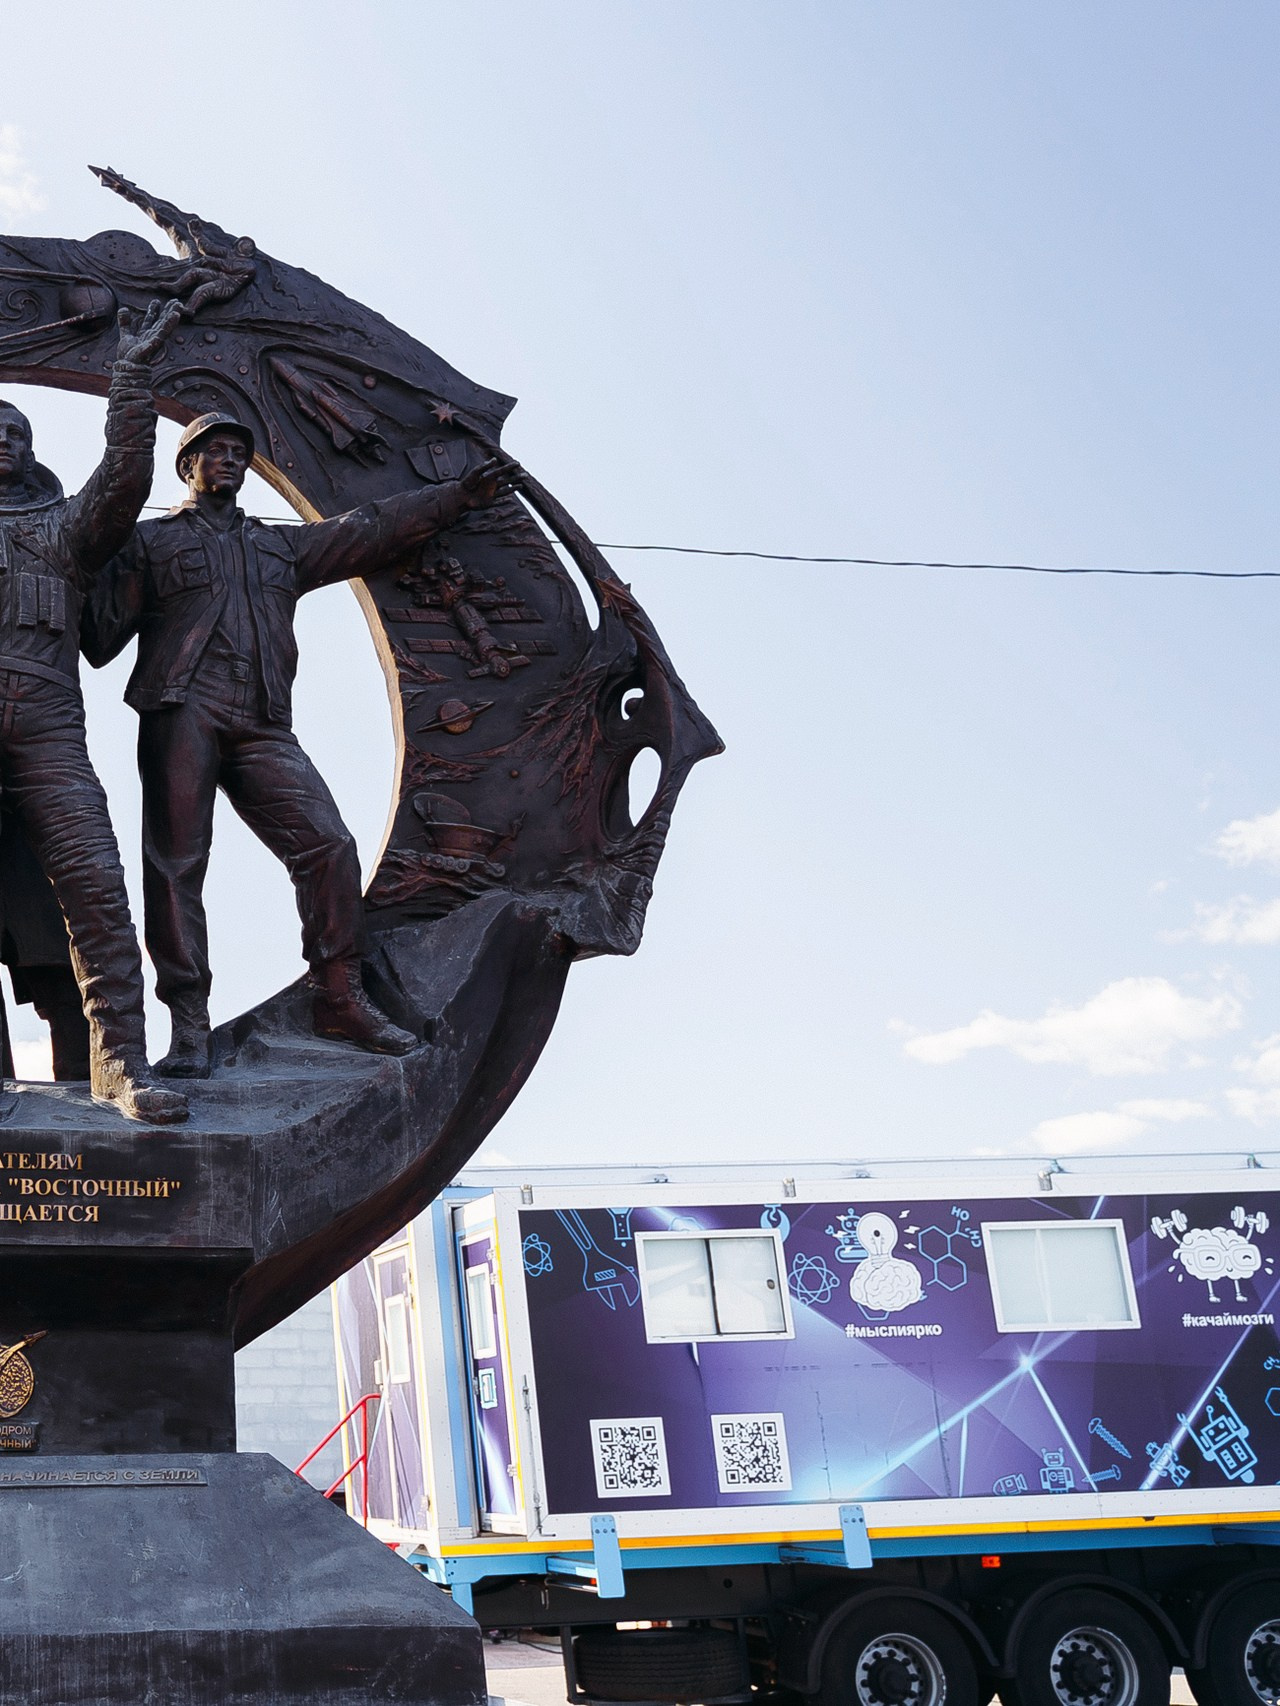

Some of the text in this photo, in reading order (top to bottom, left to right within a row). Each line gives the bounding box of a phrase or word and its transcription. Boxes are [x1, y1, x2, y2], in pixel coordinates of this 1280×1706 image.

[8, 1177, 181, 1198] "ВОСТОЧНЫЙ"
[1181, 1312, 1274, 1327] #качаймозги
[845, 1323, 942, 1339] #мыслиярко
[0, 1470, 117, 1482] НАЧИНАЕТСЯ
[123, 1470, 134, 1480] С
[138, 1470, 199, 1480] ЗЕМЛИ
